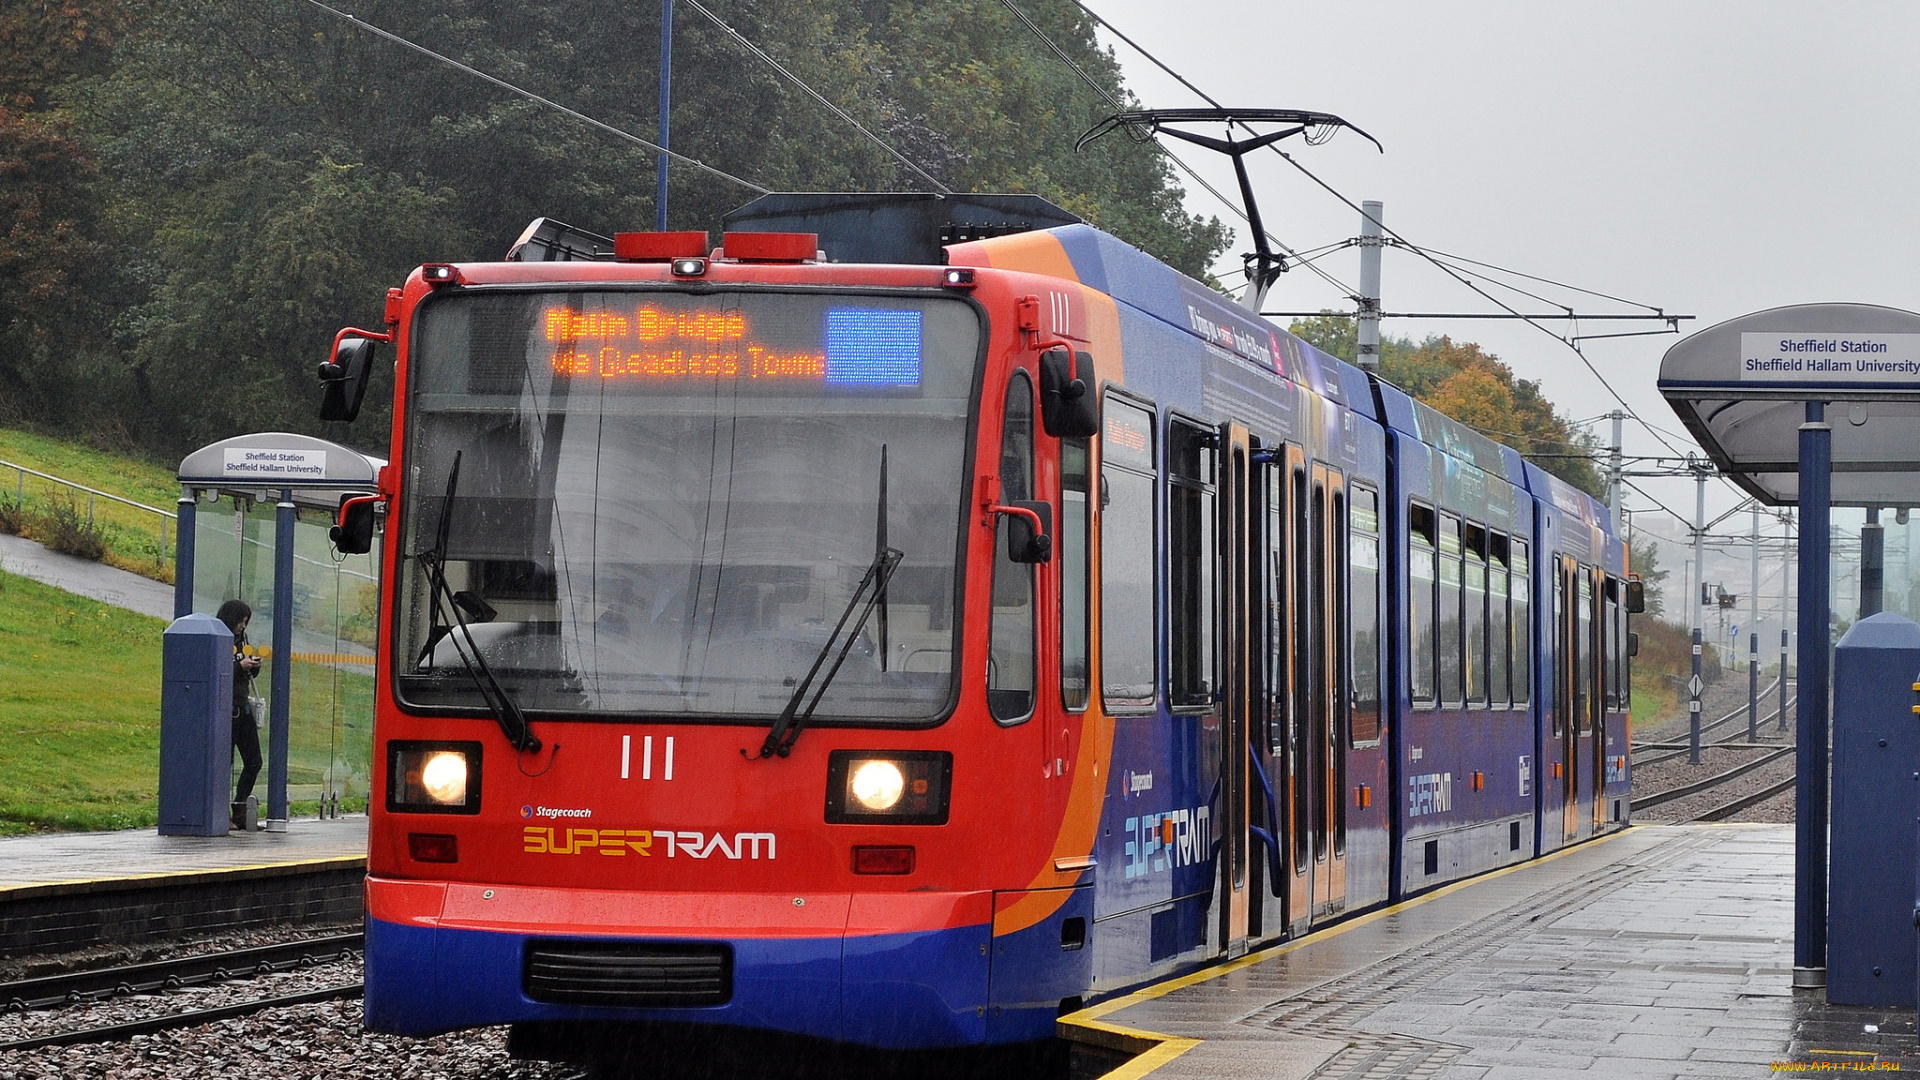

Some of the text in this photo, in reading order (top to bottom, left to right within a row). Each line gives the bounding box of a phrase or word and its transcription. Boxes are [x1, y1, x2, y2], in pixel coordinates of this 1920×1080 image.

[547, 308, 744, 340] Malin Bridge
[1779, 340, 1887, 353] Sheffield Station
[551, 349, 589, 373] via
[599, 347, 738, 377] Gleadless
[1745, 358, 1920, 375] Sheffield Hallam University
[245, 452, 305, 462] Sheffield Station
[226, 463, 323, 475] Sheffield Hallam University
[620, 735, 674, 780] 111
[535, 806, 592, 820] Stagecoach
[523, 826, 776, 859] SUPERTRAM
